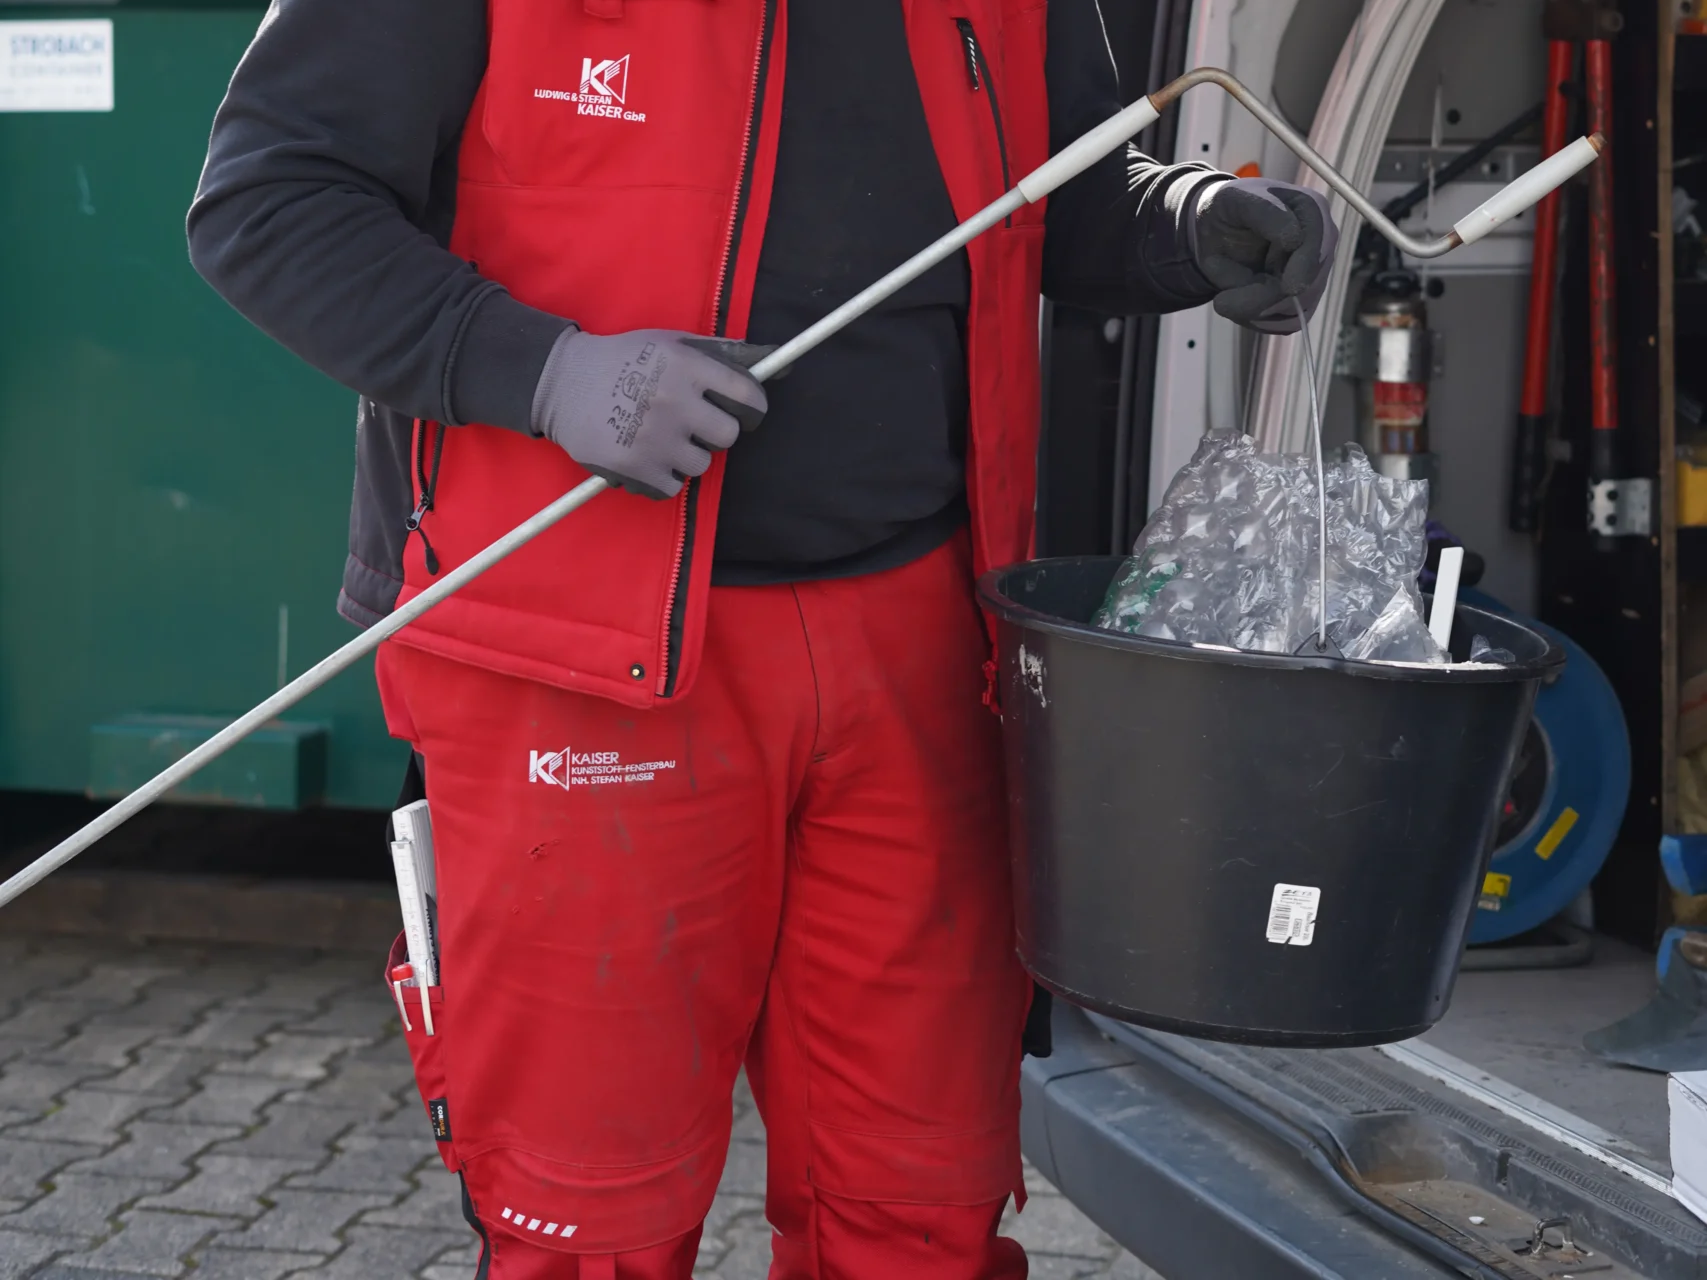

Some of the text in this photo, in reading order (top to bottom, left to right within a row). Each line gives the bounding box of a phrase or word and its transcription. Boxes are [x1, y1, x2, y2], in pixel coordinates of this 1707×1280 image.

[534, 88, 612, 105] LUDWIG & STEFAN
[577, 103, 646, 122] KAISER GbR
[571, 752, 619, 765] KAISER
[571, 772, 655, 785] INH. STEFAN KAISER
